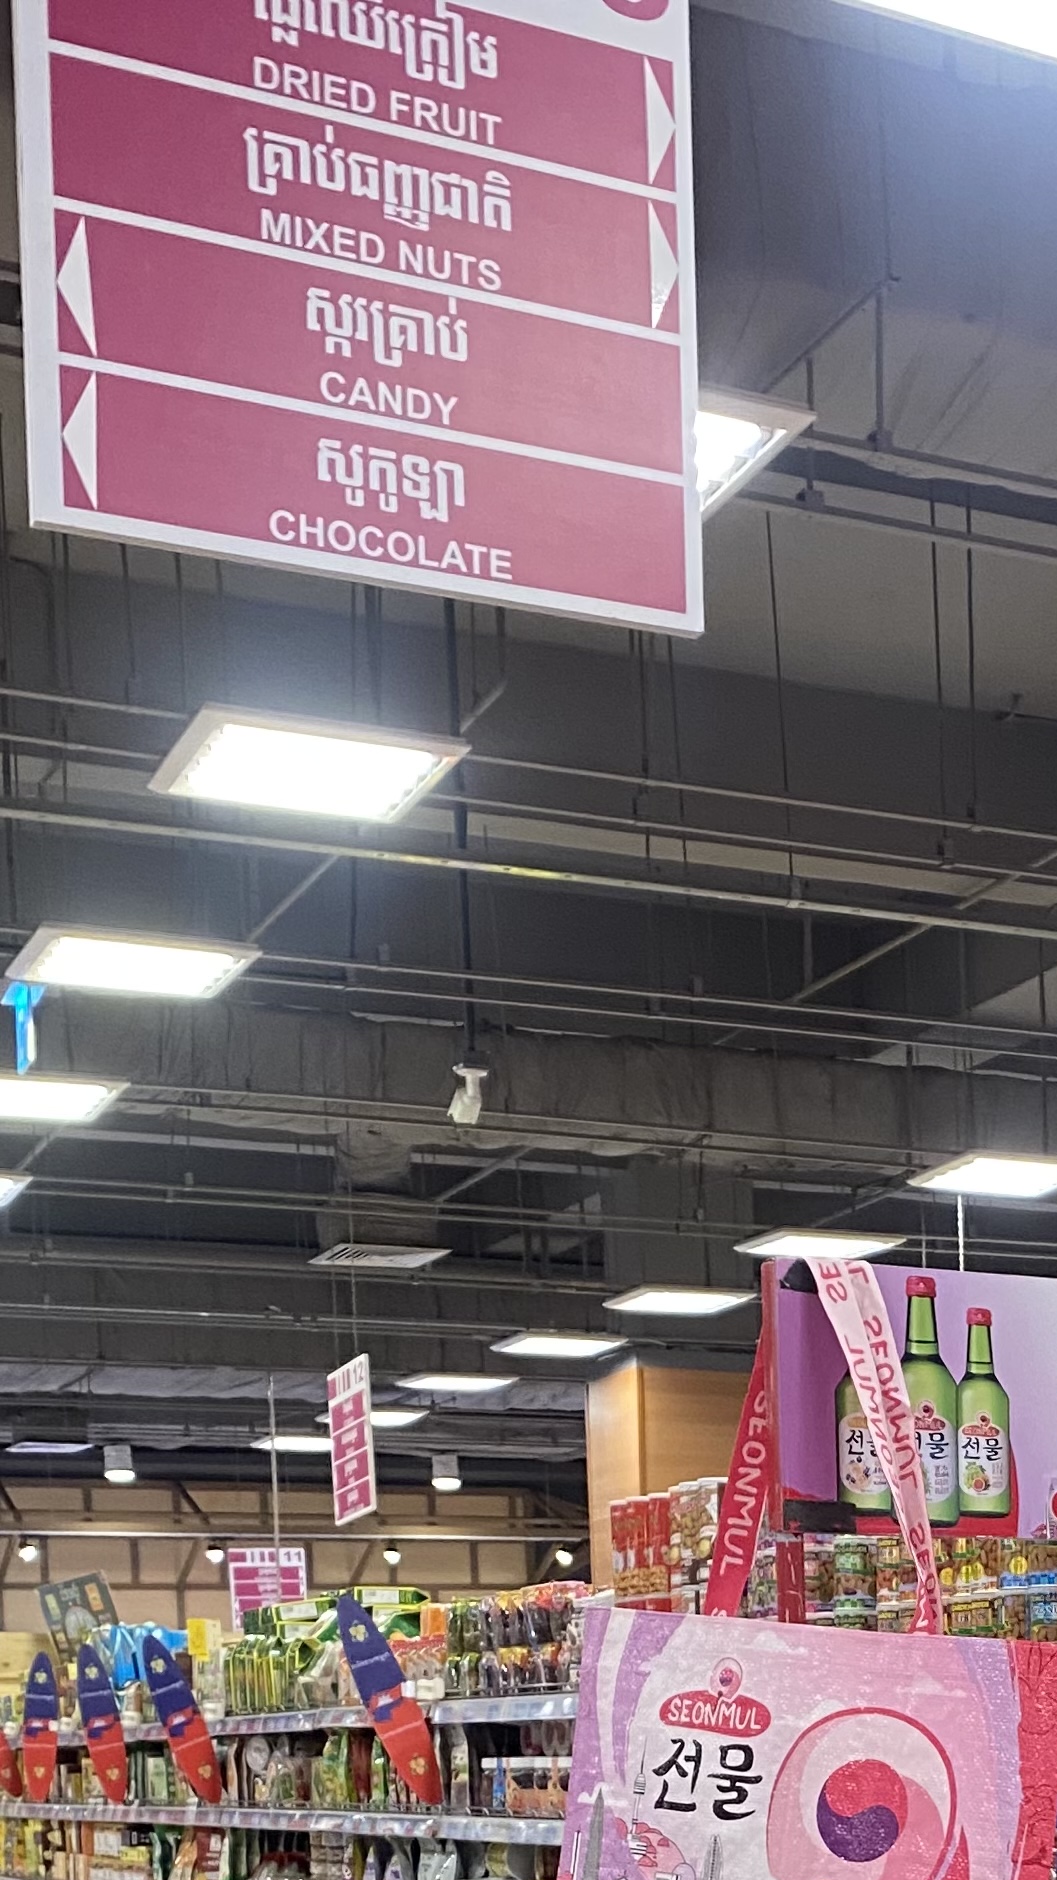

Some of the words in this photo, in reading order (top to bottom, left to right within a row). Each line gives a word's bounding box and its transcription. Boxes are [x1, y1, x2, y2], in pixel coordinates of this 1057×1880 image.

[253, 55, 377, 114] DRIED
[390, 89, 503, 145] FRUIT
[243, 125, 512, 231] គ្រាប់ធញ្ញជាតិ
[260, 208, 386, 265] MIXED
[399, 240, 502, 291] NUTS
[306, 287, 468, 368] ស្ករគ្រាប់
[320, 371, 459, 425] CANDY
[317, 437, 466, 523] សូកូឡា
[268, 509, 513, 581] CHOCOLATE
[353, 1360, 364, 1385] 12
[283, 1550, 301, 1562] 11
[667, 1696, 761, 1730] SEONMUL
